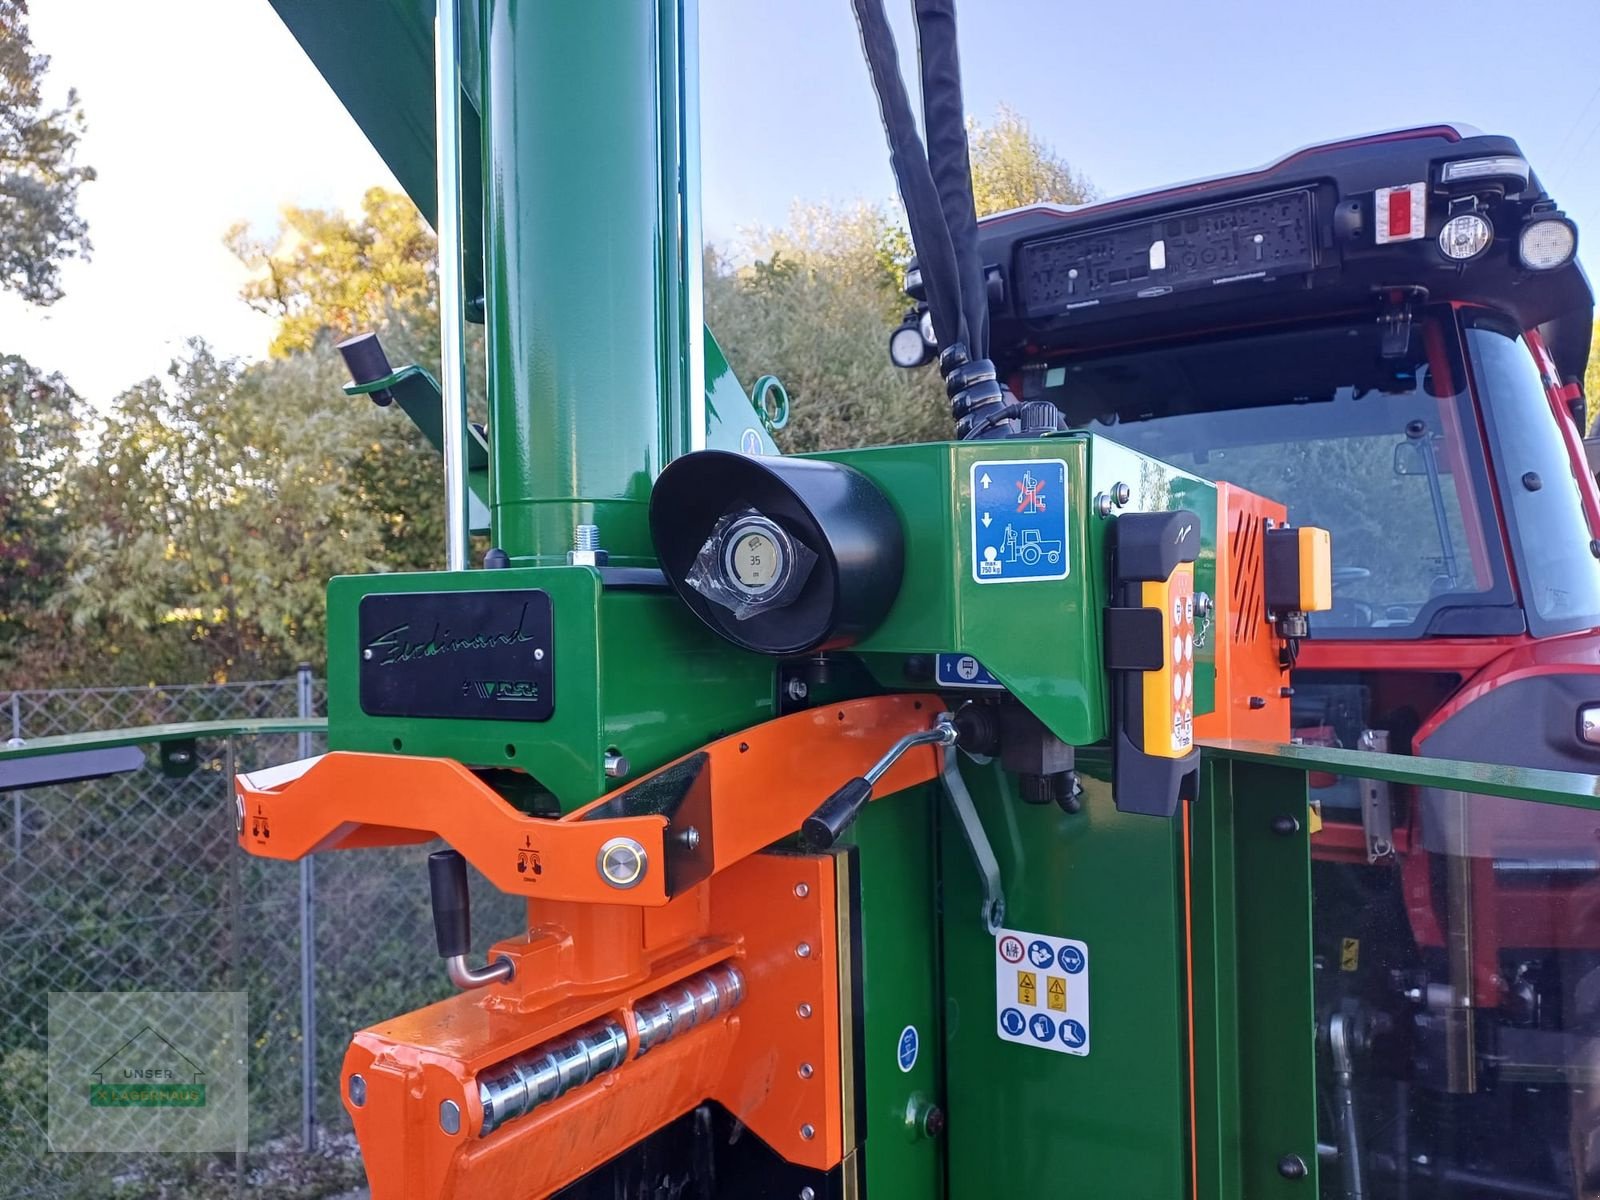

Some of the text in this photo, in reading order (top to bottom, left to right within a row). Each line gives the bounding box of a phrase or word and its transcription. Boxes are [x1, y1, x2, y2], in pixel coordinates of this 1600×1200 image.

[750, 555, 760, 566] 35
[982, 566, 1001, 574] 750 kg
